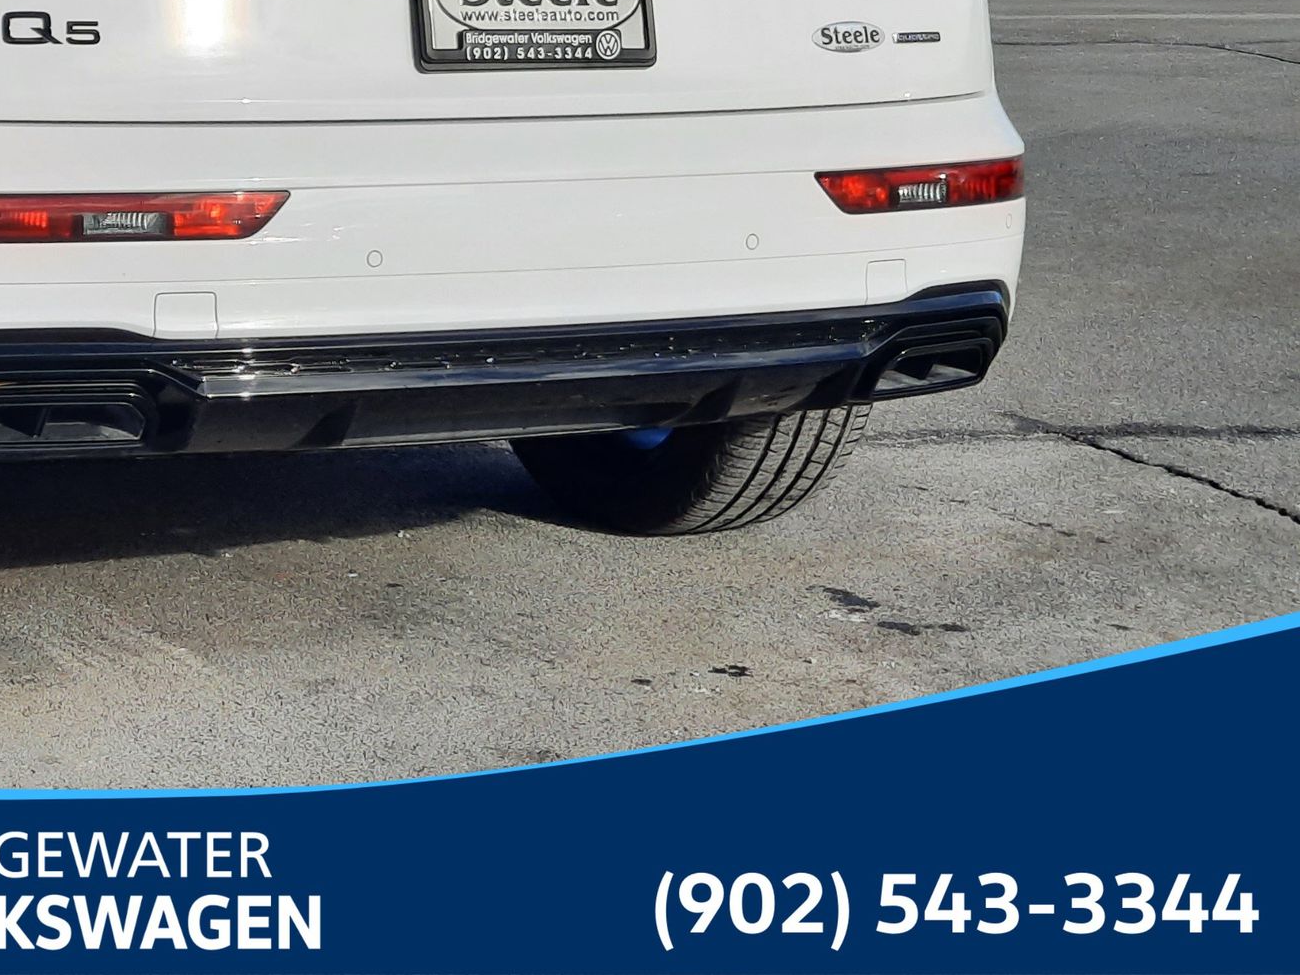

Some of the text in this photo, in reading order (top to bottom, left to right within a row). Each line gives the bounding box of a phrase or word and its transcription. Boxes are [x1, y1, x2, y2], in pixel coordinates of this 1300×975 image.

[460, 8, 620, 21] www.steeleauto.com
[2, 11, 101, 45] Q5
[466, 32, 593, 46] Bridgewater Volkswagen
[820, 26, 880, 45] Steele
[466, 46, 593, 60] (902) 543-3344
